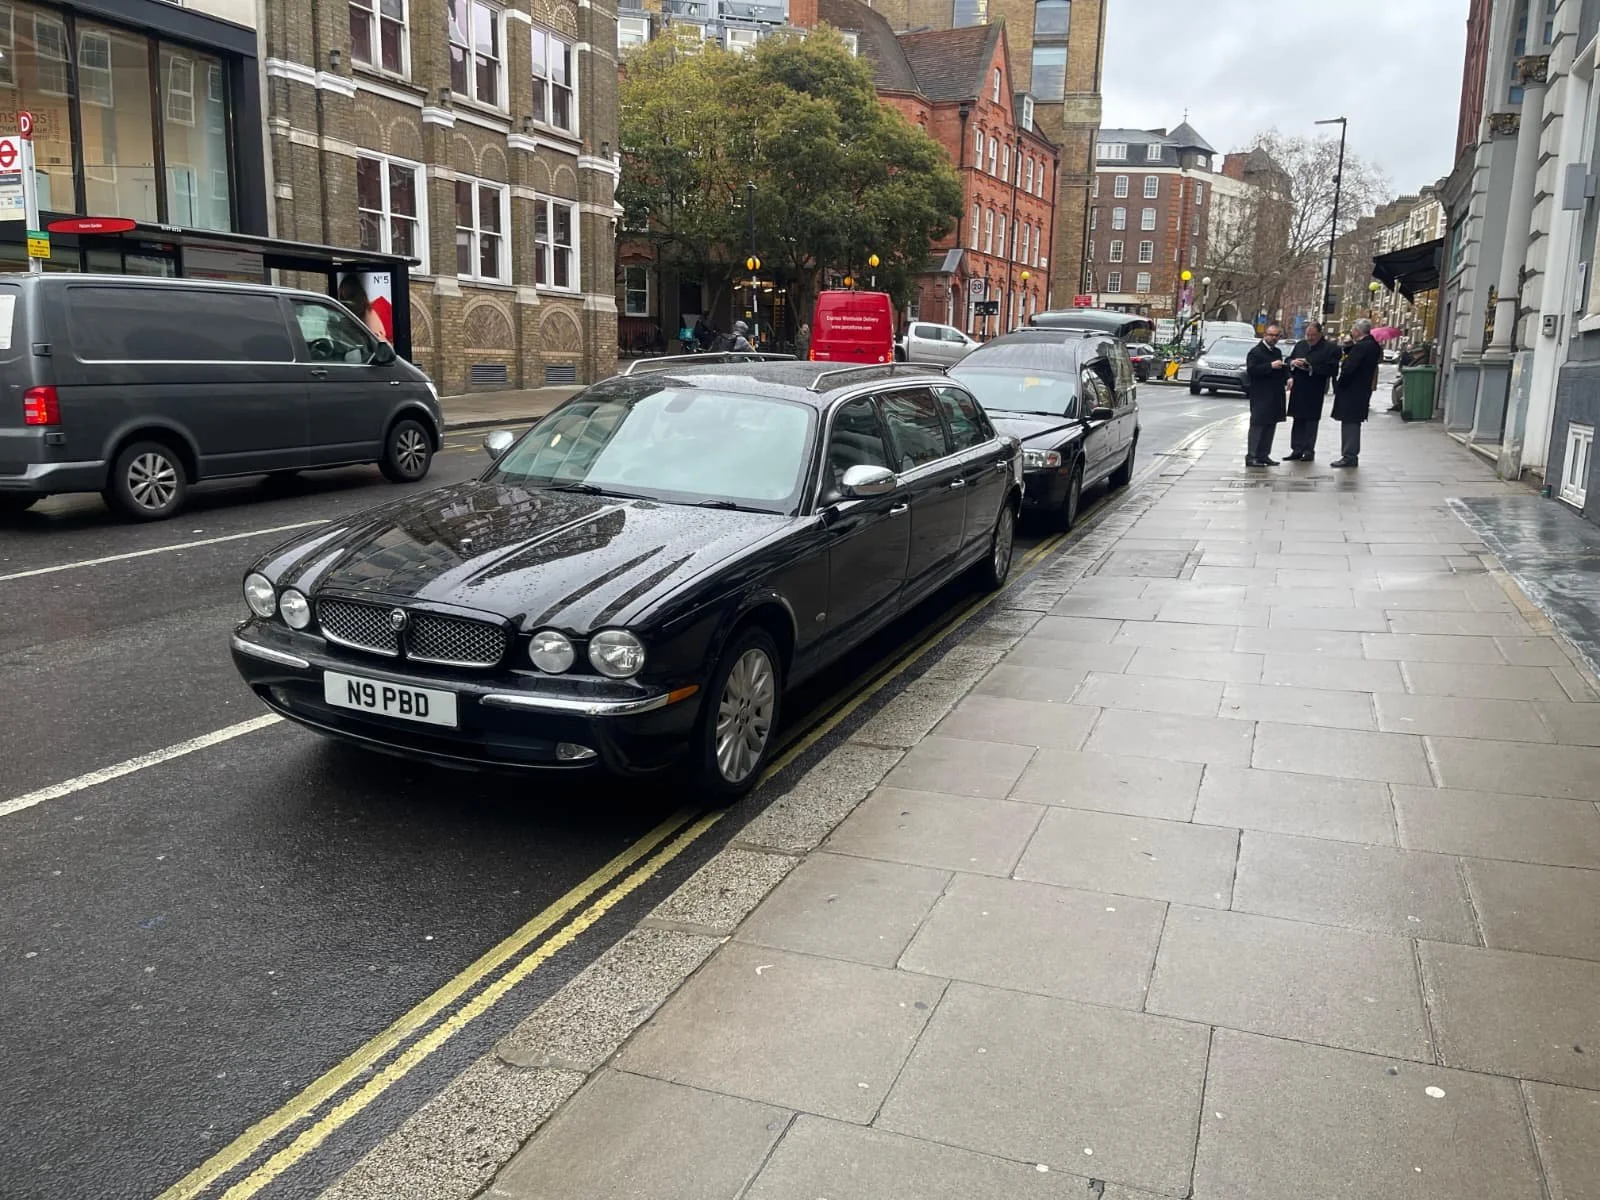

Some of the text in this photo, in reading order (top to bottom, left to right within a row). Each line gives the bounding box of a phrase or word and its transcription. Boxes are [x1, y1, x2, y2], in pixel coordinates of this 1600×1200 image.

[20, 116, 30, 132] D
[347, 679, 429, 717] N9 PBD
